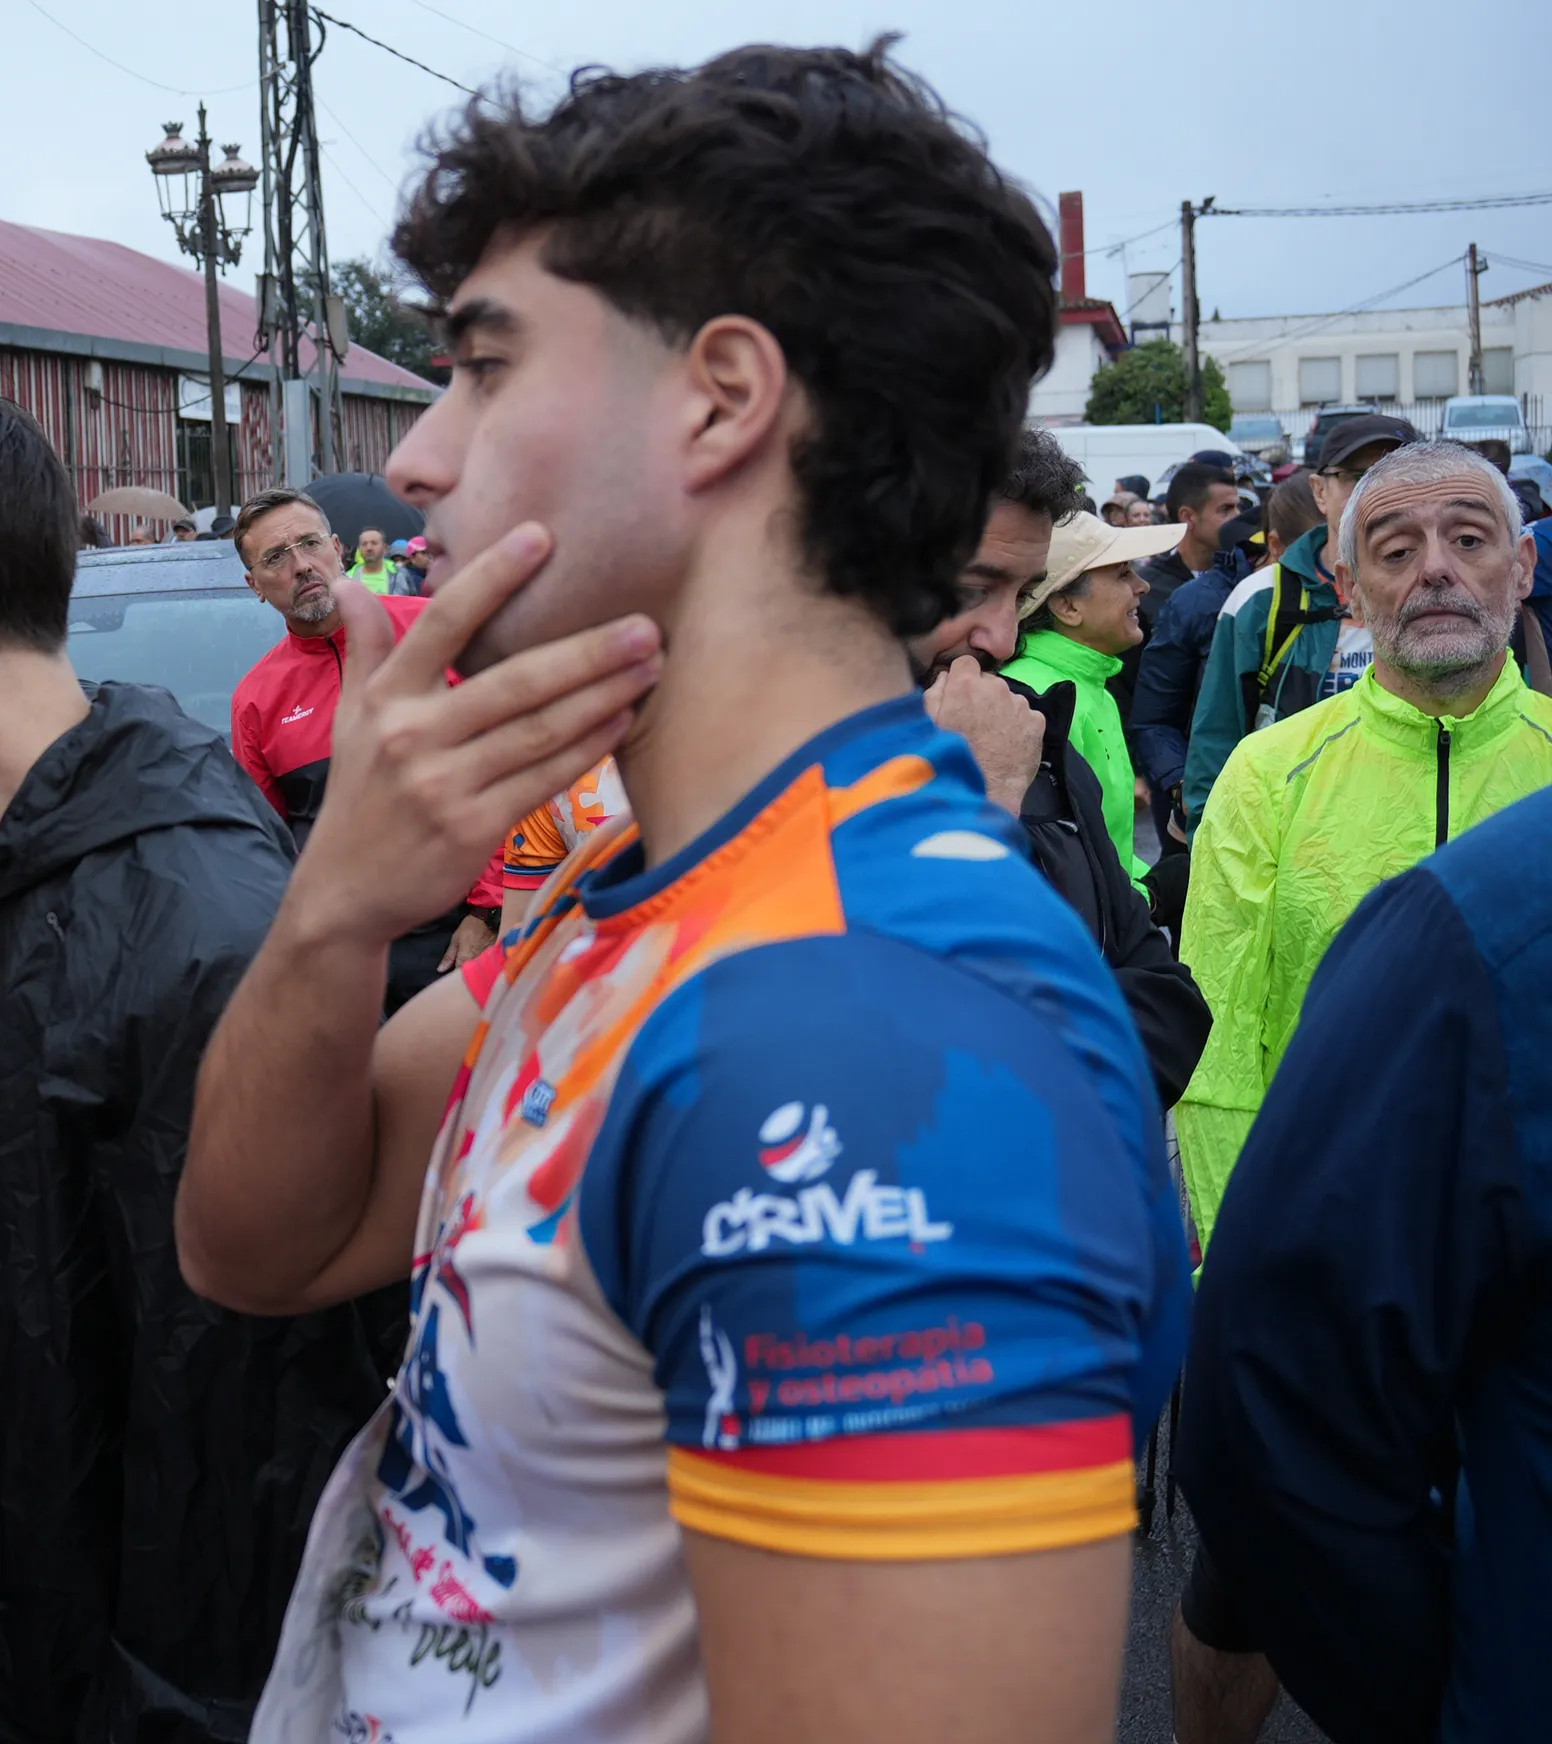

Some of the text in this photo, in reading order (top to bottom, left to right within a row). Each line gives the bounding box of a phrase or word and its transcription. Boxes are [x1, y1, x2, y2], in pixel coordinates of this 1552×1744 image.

[702, 1168, 954, 1257] CRIVEL
[745, 1315, 986, 1371] Fisioterapia
[749, 1380, 770, 1414] y
